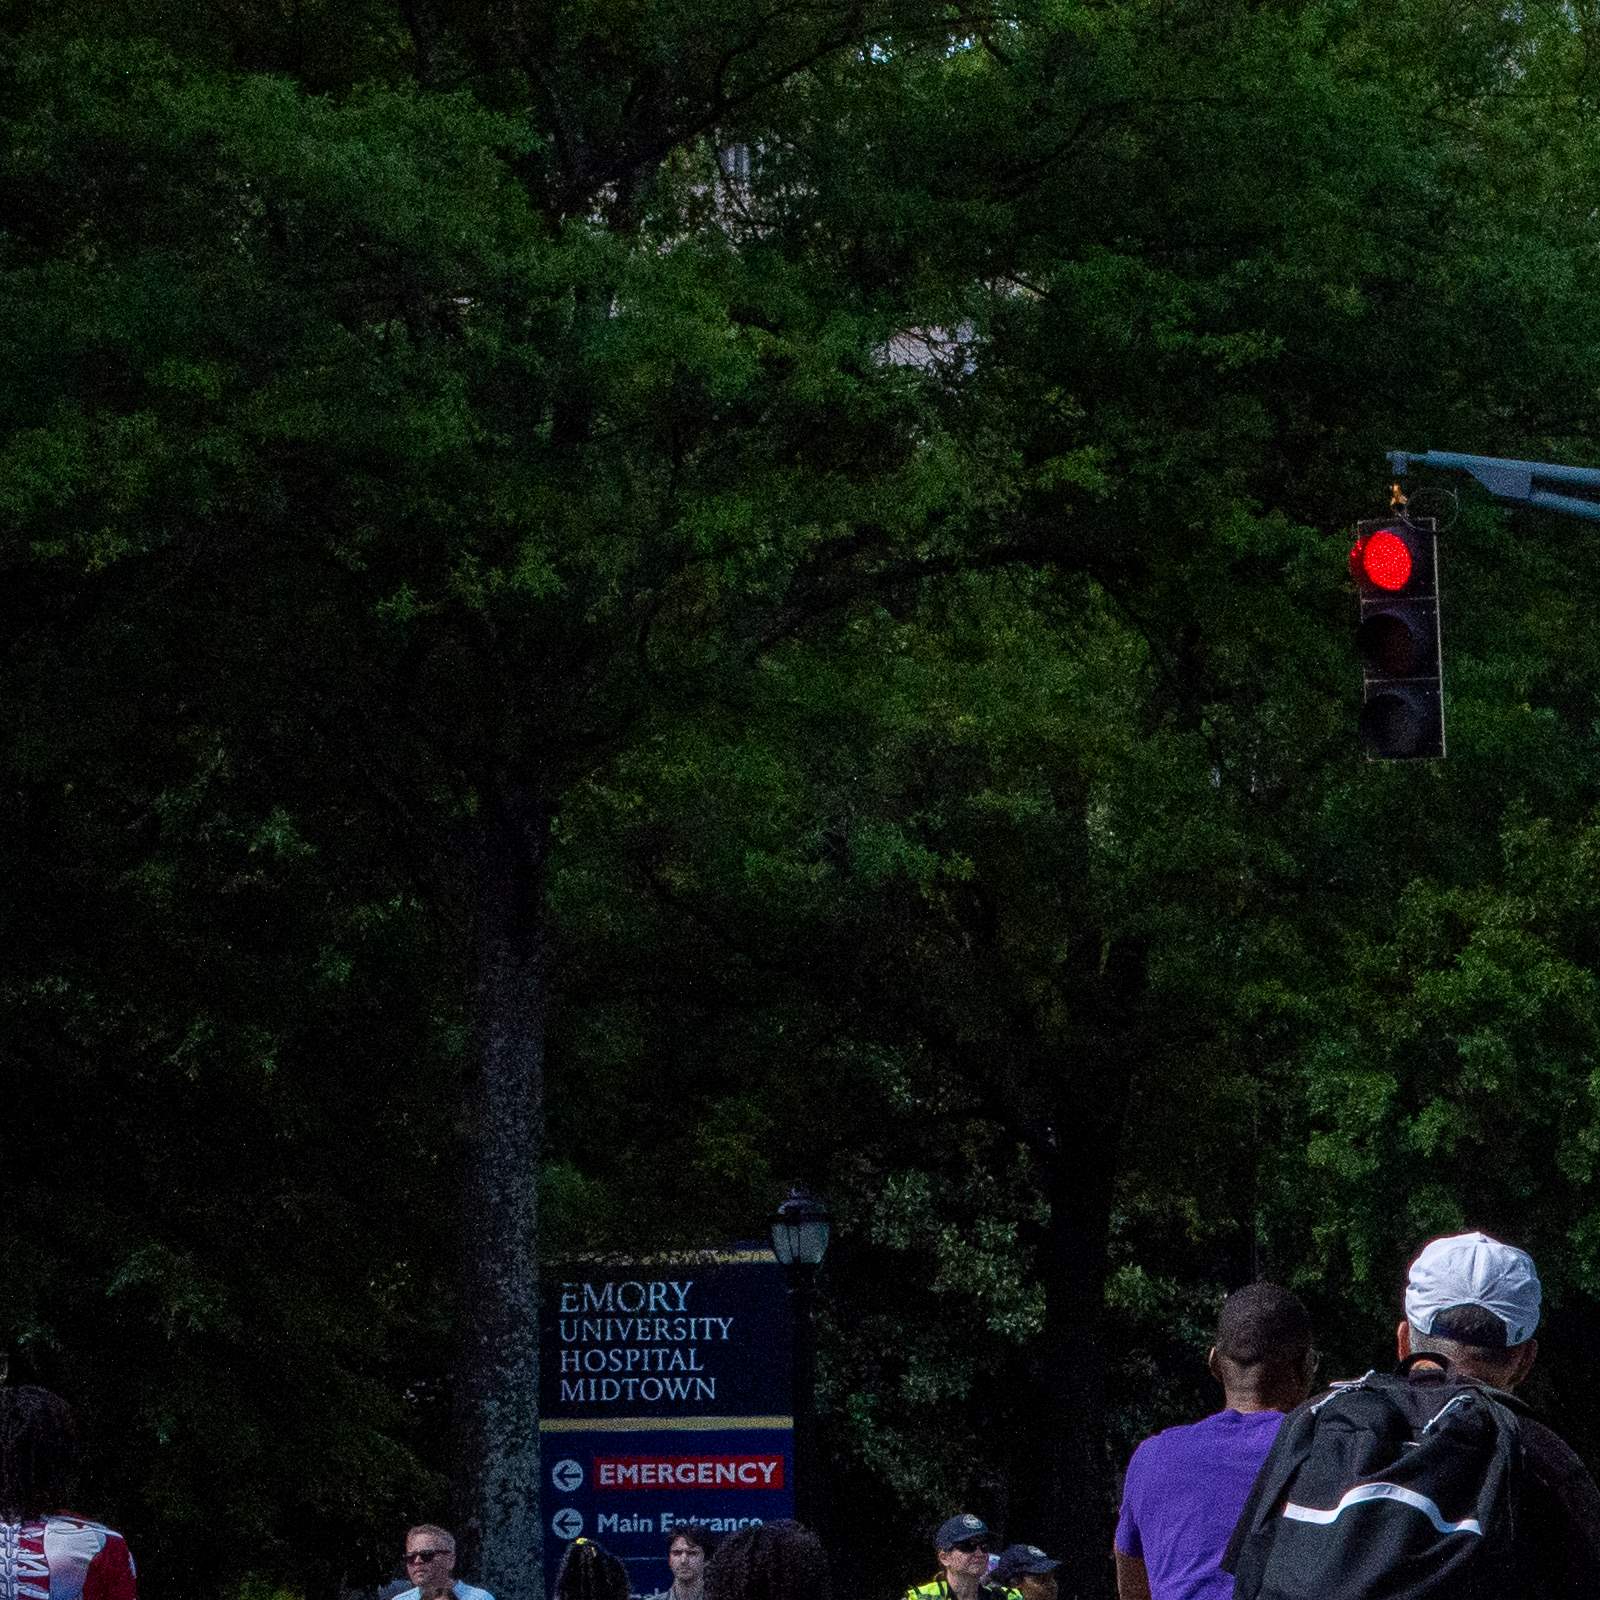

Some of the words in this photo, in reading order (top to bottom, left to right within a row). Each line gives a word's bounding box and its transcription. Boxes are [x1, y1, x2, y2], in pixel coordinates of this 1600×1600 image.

[559, 1281, 693, 1313] EMORY
[559, 1317, 734, 1342] UNIVERSITY
[560, 1349, 704, 1373] HOSPITAL
[560, 1377, 717, 1401] MIDTOWN
[599, 1462, 778, 1485] EMERGENCY
[597, 1513, 652, 1533] Main
